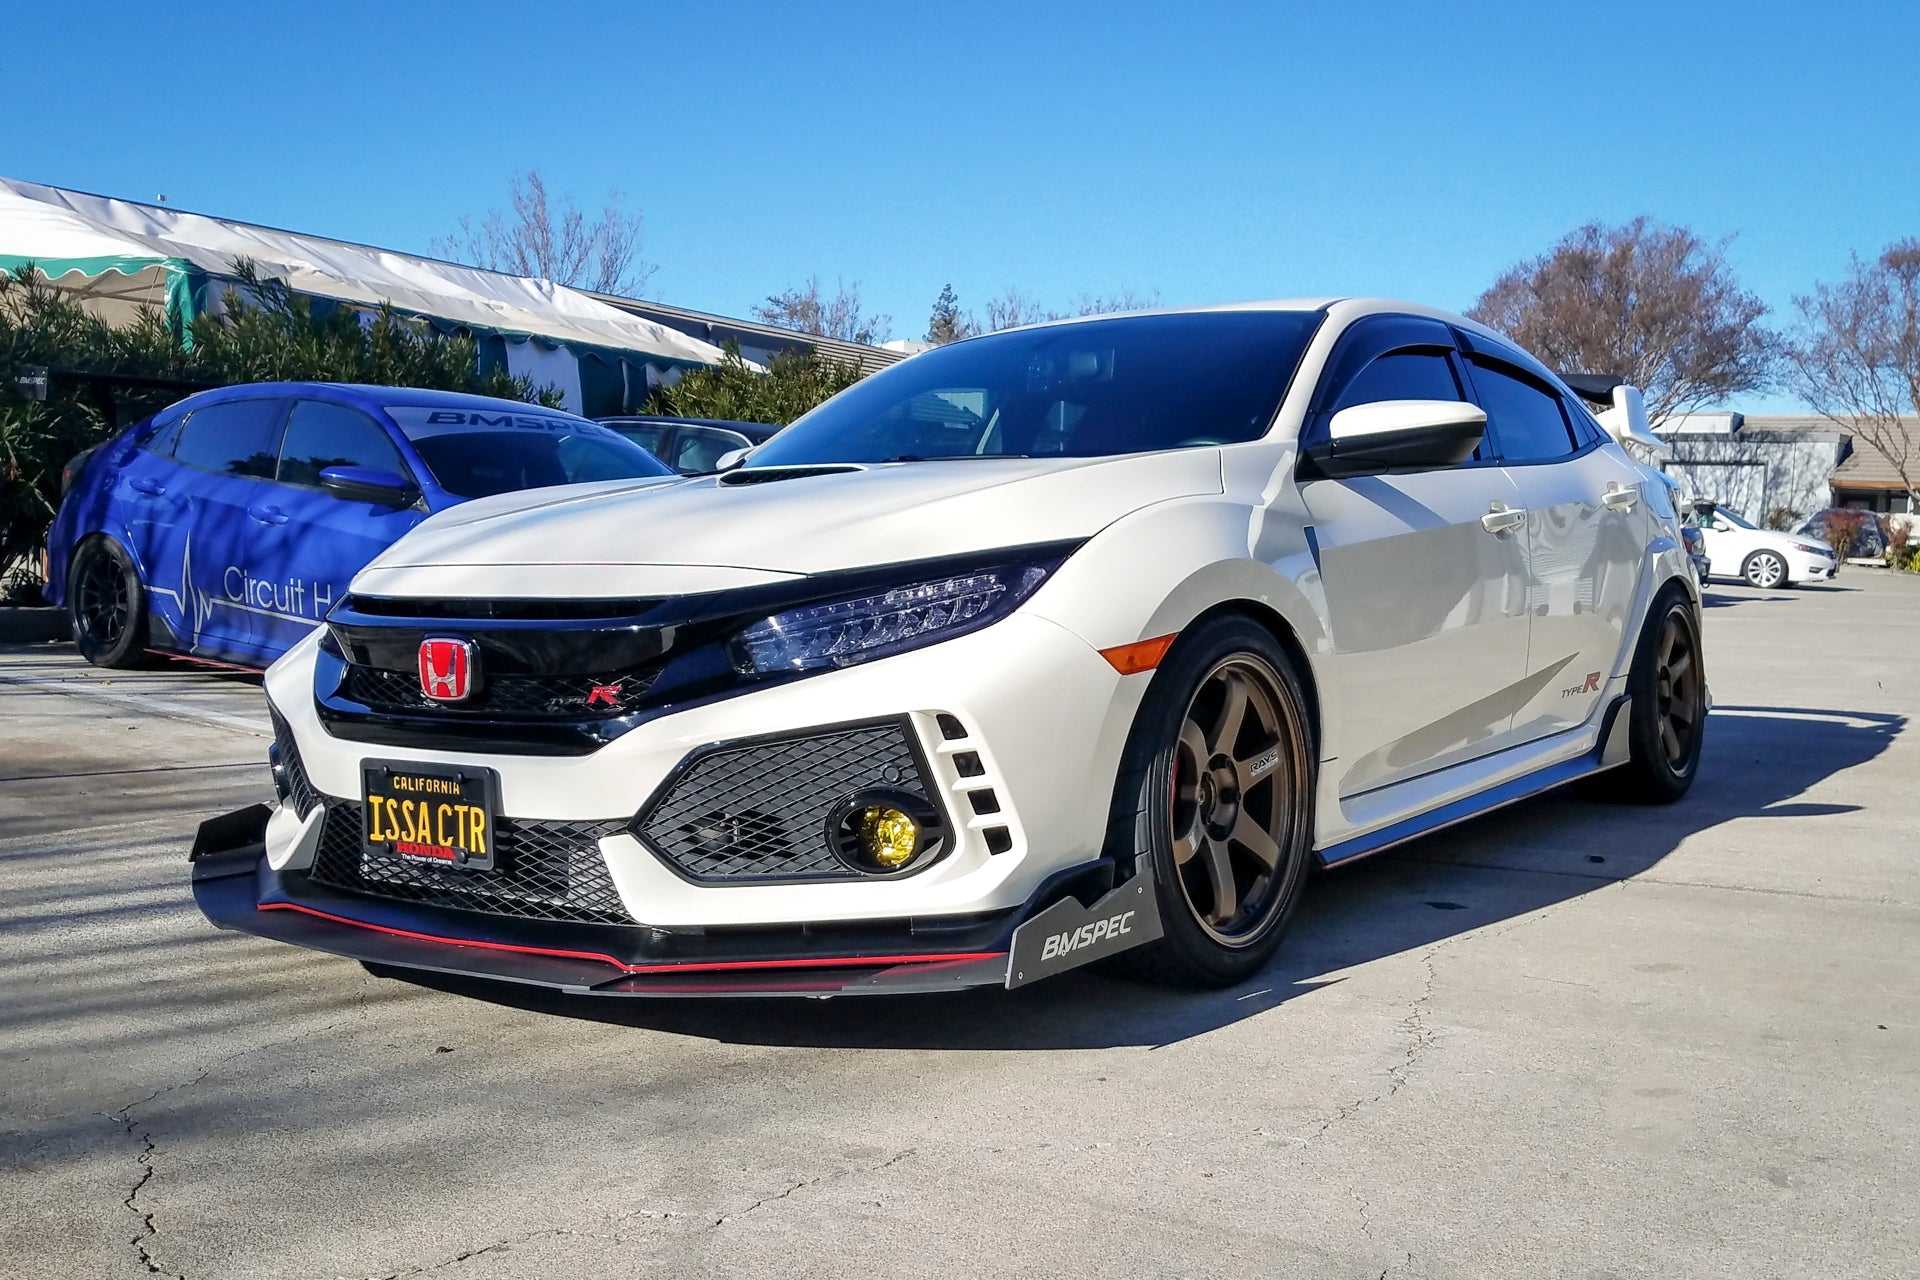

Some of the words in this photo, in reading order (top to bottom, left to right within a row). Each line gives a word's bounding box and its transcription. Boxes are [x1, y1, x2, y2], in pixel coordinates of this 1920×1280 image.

[224, 566, 305, 615] Circuit
[1250, 750, 1277, 773] RAYS
[393, 776, 460, 795] CALIFORNIA
[368, 795, 432, 845] ISSA
[437, 803, 486, 854] CTR
[396, 841, 457, 860] HONDA
[411, 854, 426, 862] Power
[433, 857, 453, 865] Dreams
[1040, 910, 1135, 962] BMSPEC
